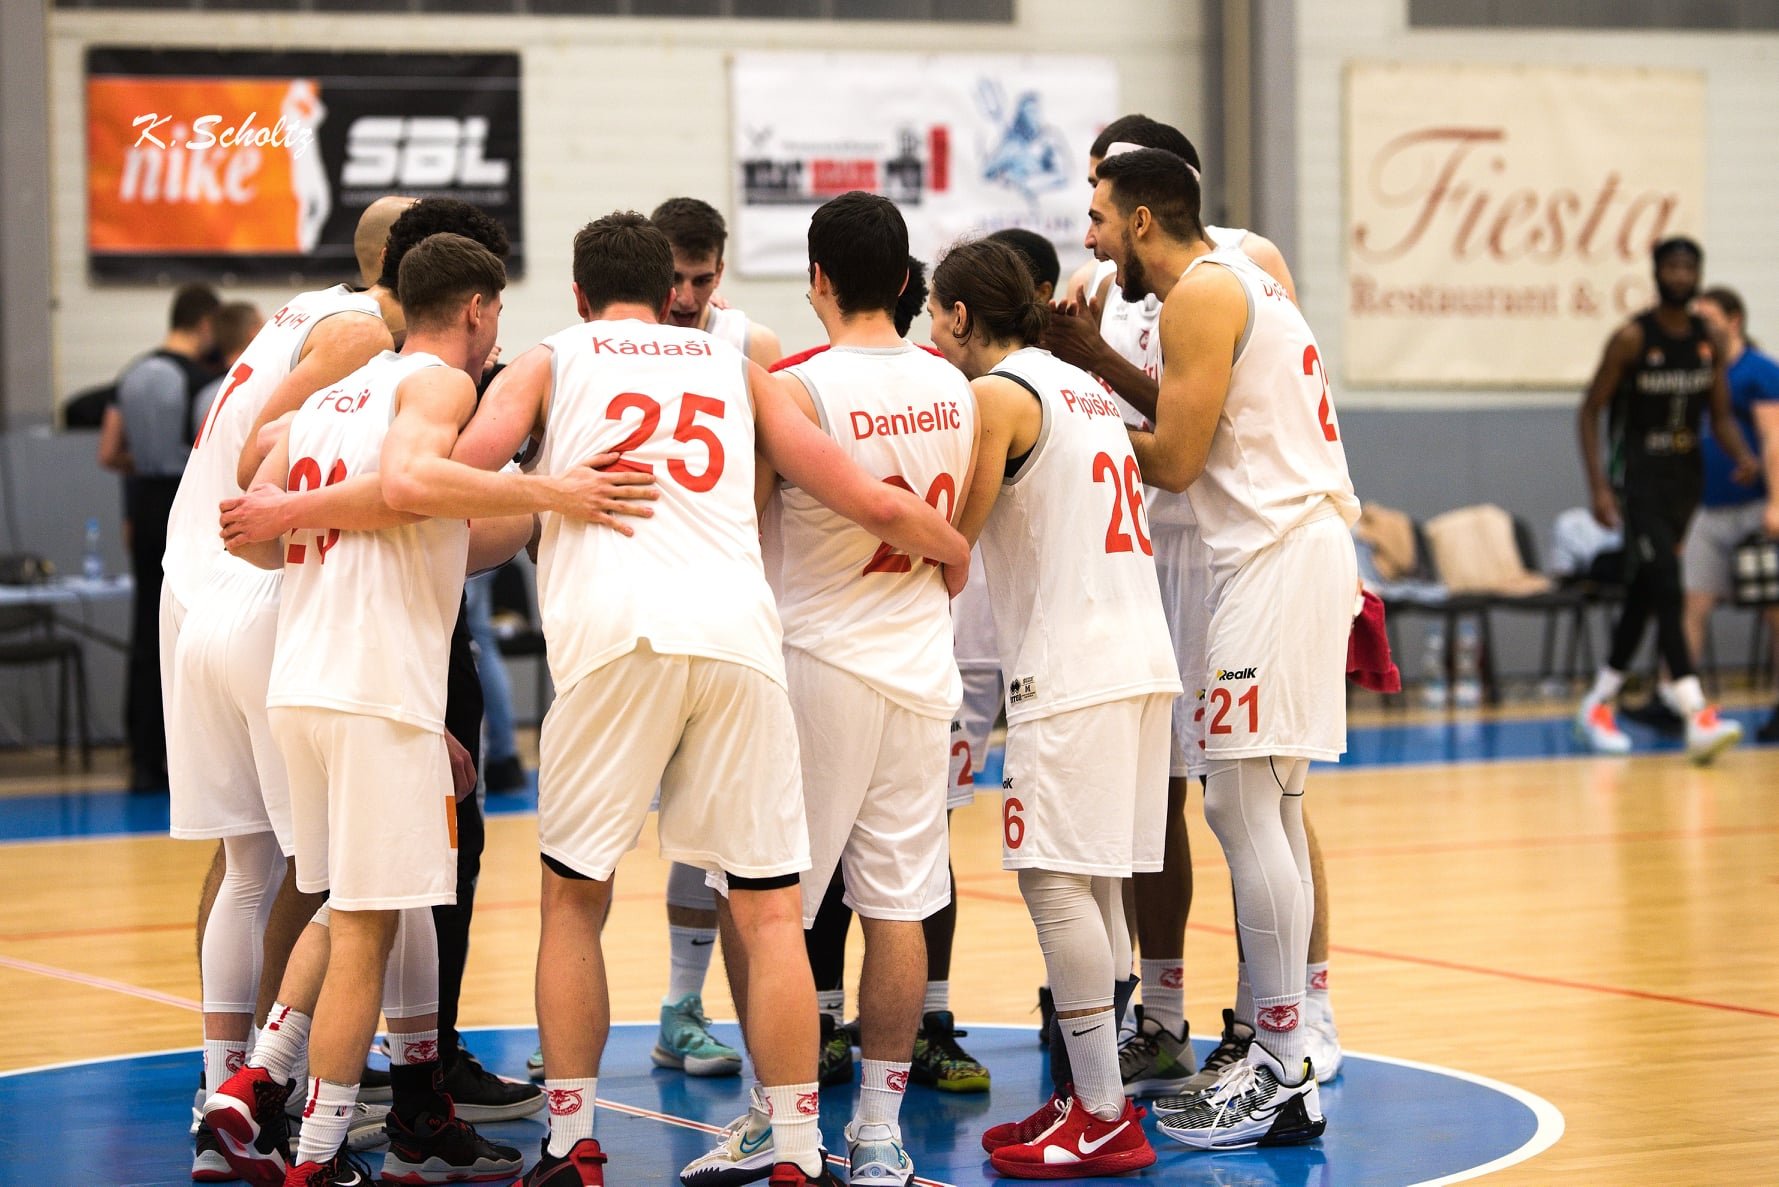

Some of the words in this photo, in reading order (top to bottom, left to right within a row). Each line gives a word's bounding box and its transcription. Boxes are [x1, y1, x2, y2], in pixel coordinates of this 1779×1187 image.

[340, 115, 509, 186] SBL
[1351, 126, 1680, 265] Fiesta
[592, 337, 712, 356] Kádaši
[598, 391, 726, 493] 25
[850, 402, 960, 440] Danielič
[1092, 451, 1153, 556] 26
[1217, 667, 1258, 681] RealK
[1210, 685, 1259, 735] 21
